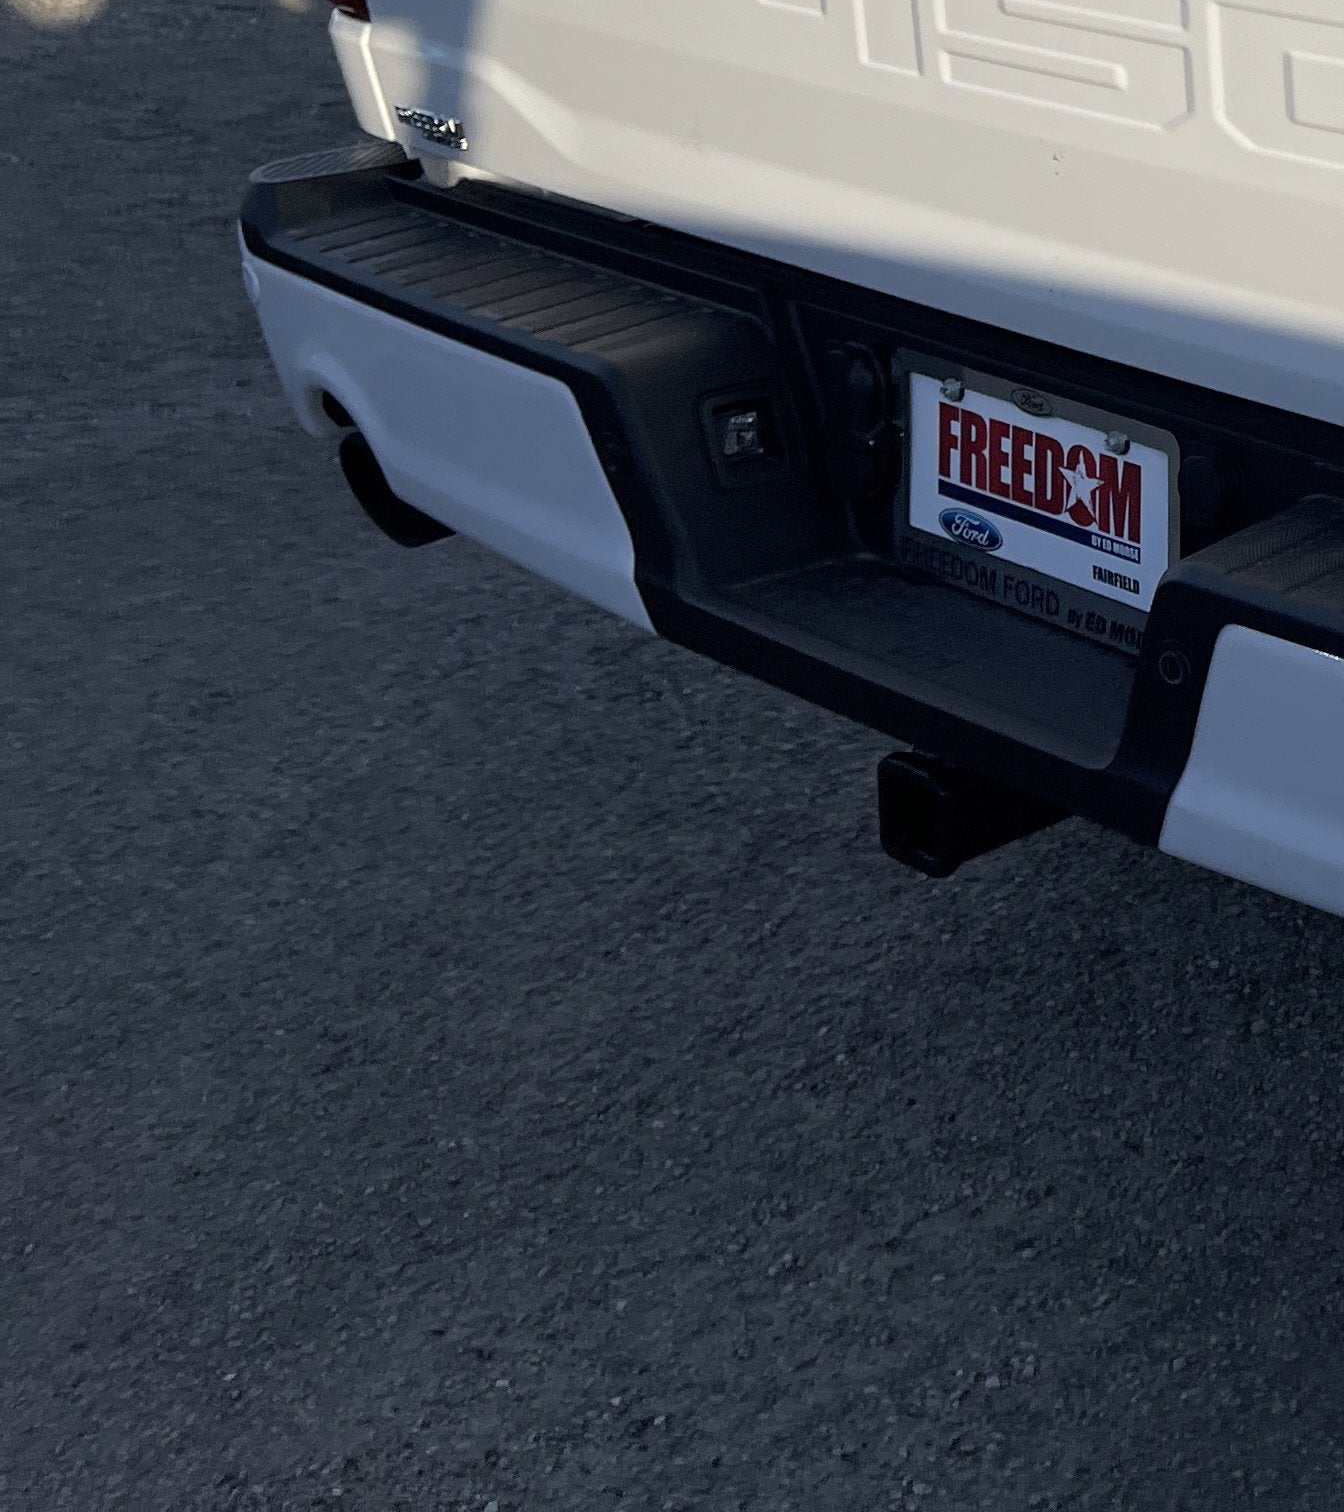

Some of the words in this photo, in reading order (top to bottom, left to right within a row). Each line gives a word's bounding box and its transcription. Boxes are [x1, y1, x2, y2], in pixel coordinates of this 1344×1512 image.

[938, 400, 1141, 544] FREEDOM
[949, 512, 991, 548] Ford
[1003, 575, 1060, 616] FORD
[1092, 565, 1140, 594] FAIRFIELD
